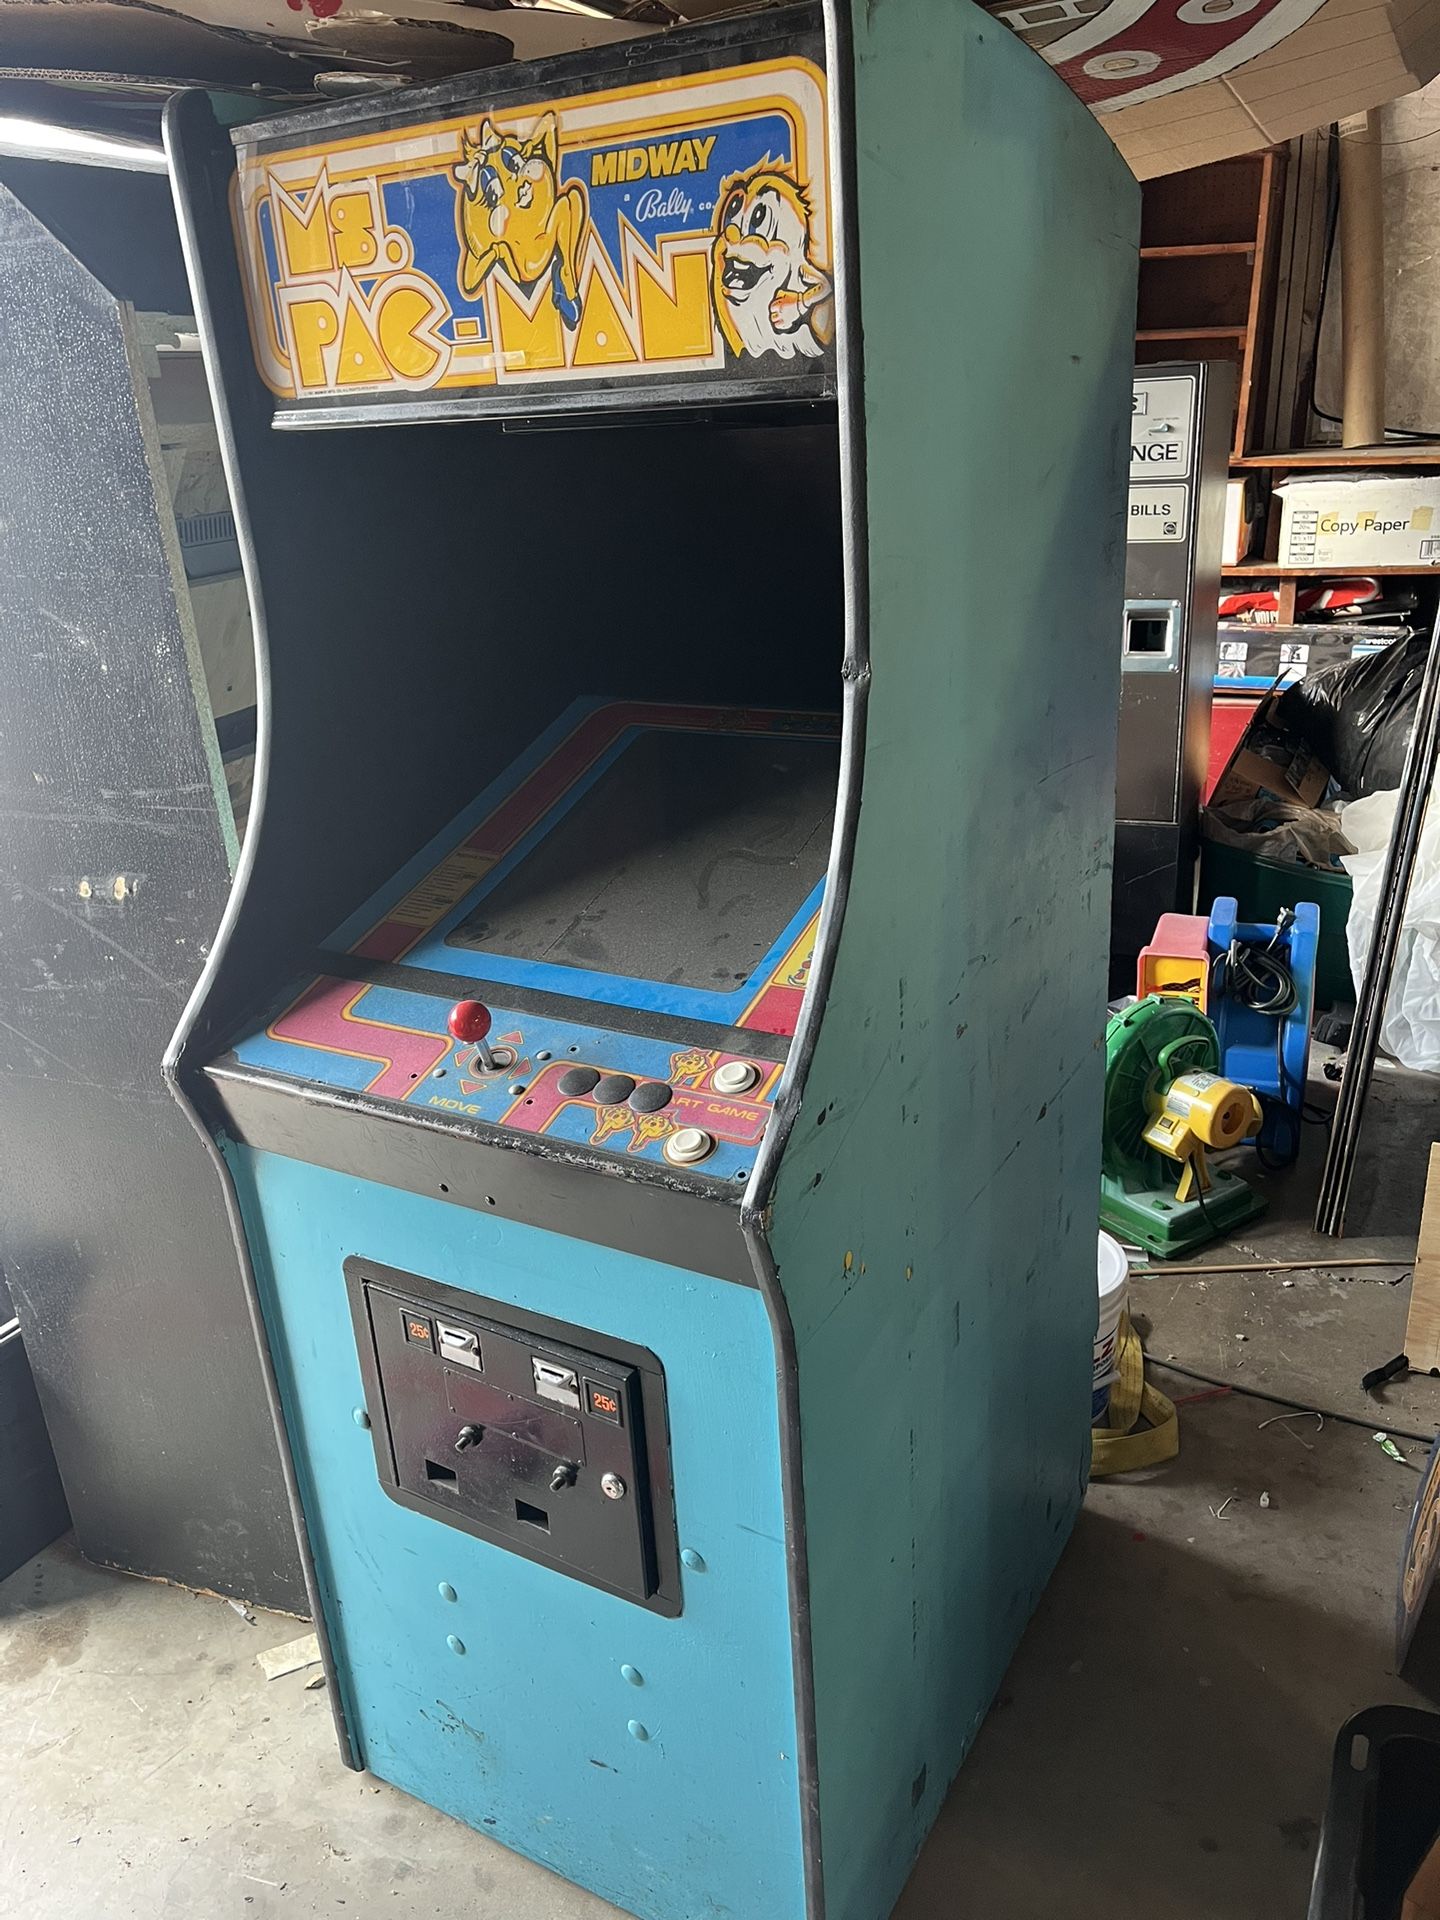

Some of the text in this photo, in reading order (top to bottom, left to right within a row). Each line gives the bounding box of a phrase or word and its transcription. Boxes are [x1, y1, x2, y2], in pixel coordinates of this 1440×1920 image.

[590, 135, 718, 188] MIDWAY
[635, 187, 692, 223] Bally
[282, 222, 717, 391] PAC-MAN
[1131, 443, 1179, 462] NGE
[1130, 503, 1171, 516] BILLS
[1320, 518, 1410, 535] Copy Paper
[428, 1095, 482, 1115] MOVE
[706, 1103, 760, 1121] GAME
[409, 1321, 430, 1339] 25¢
[593, 1392, 617, 1412] 25¢
